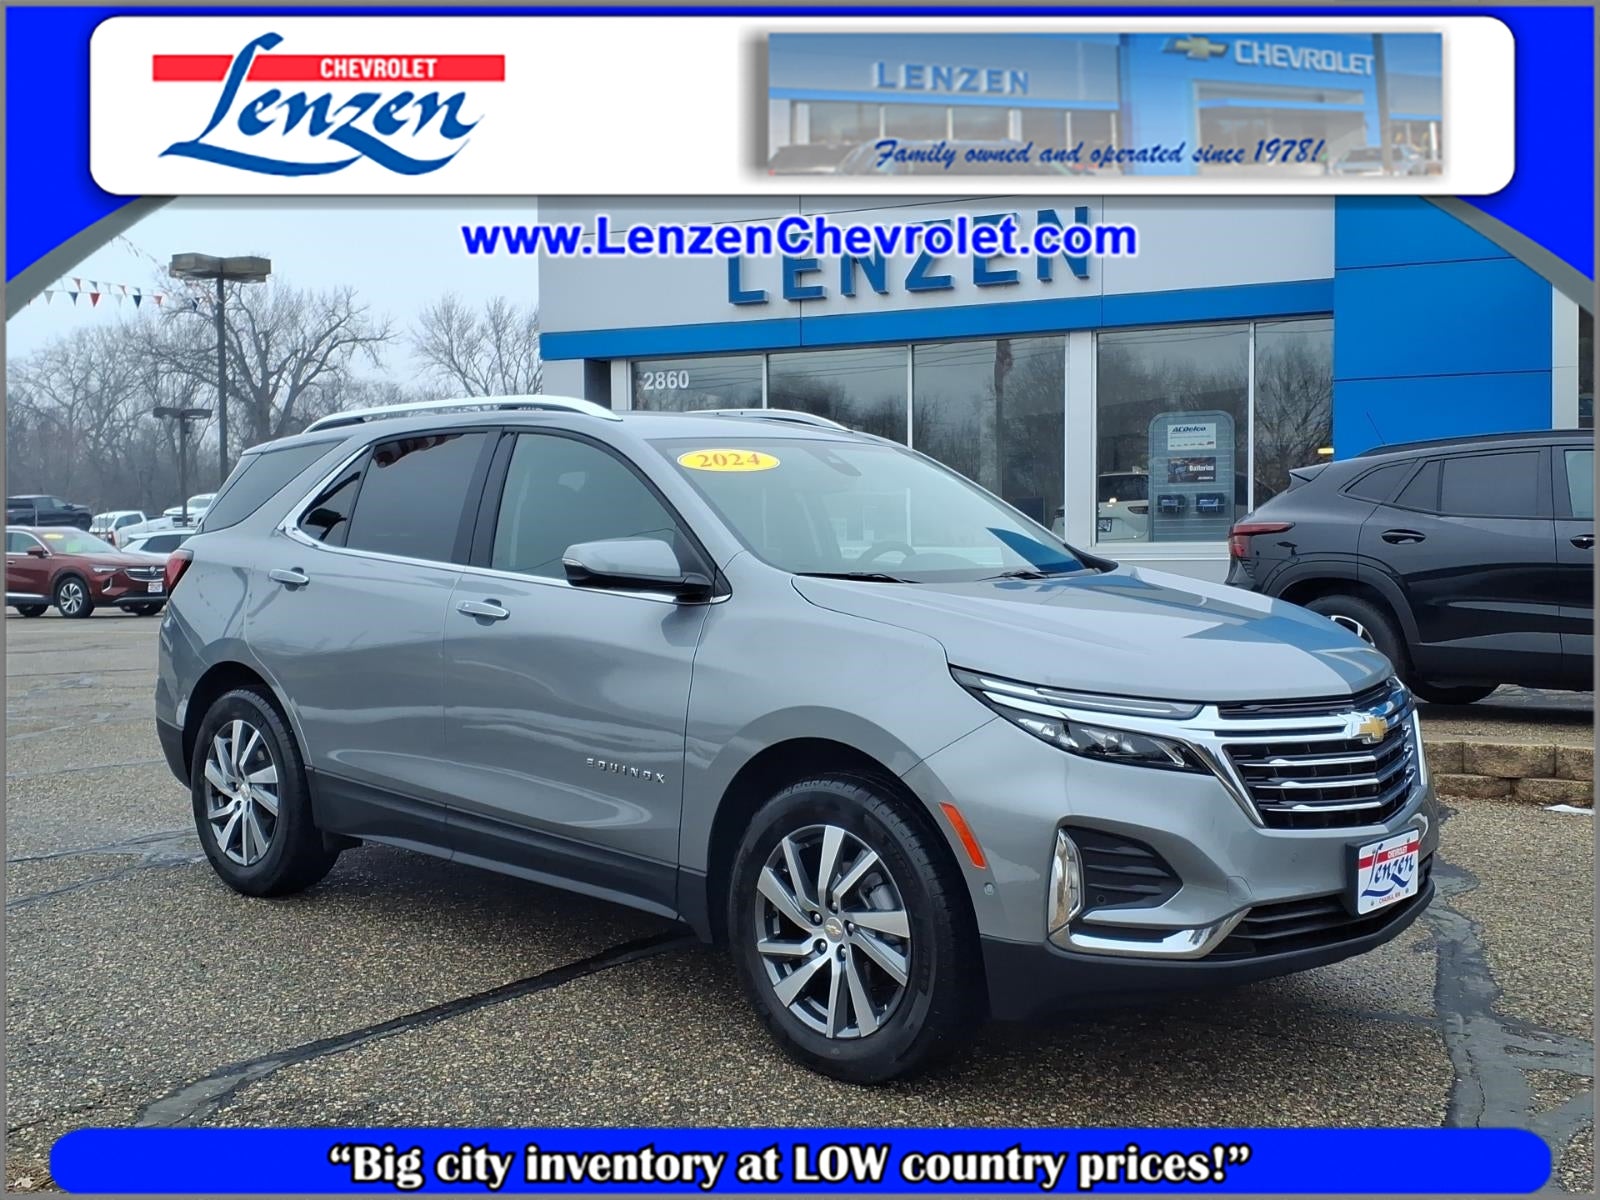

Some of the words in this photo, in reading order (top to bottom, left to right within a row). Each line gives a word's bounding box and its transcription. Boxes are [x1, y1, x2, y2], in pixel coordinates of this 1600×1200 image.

[727, 205, 1091, 306] LENZEN
[643, 369, 690, 391] 2860
[1172, 425, 1207, 433] ACDelco
[697, 452, 761, 468] 2024
[586, 757, 666, 784] EQUINOX
[1361, 843, 1415, 897] Lenzen
